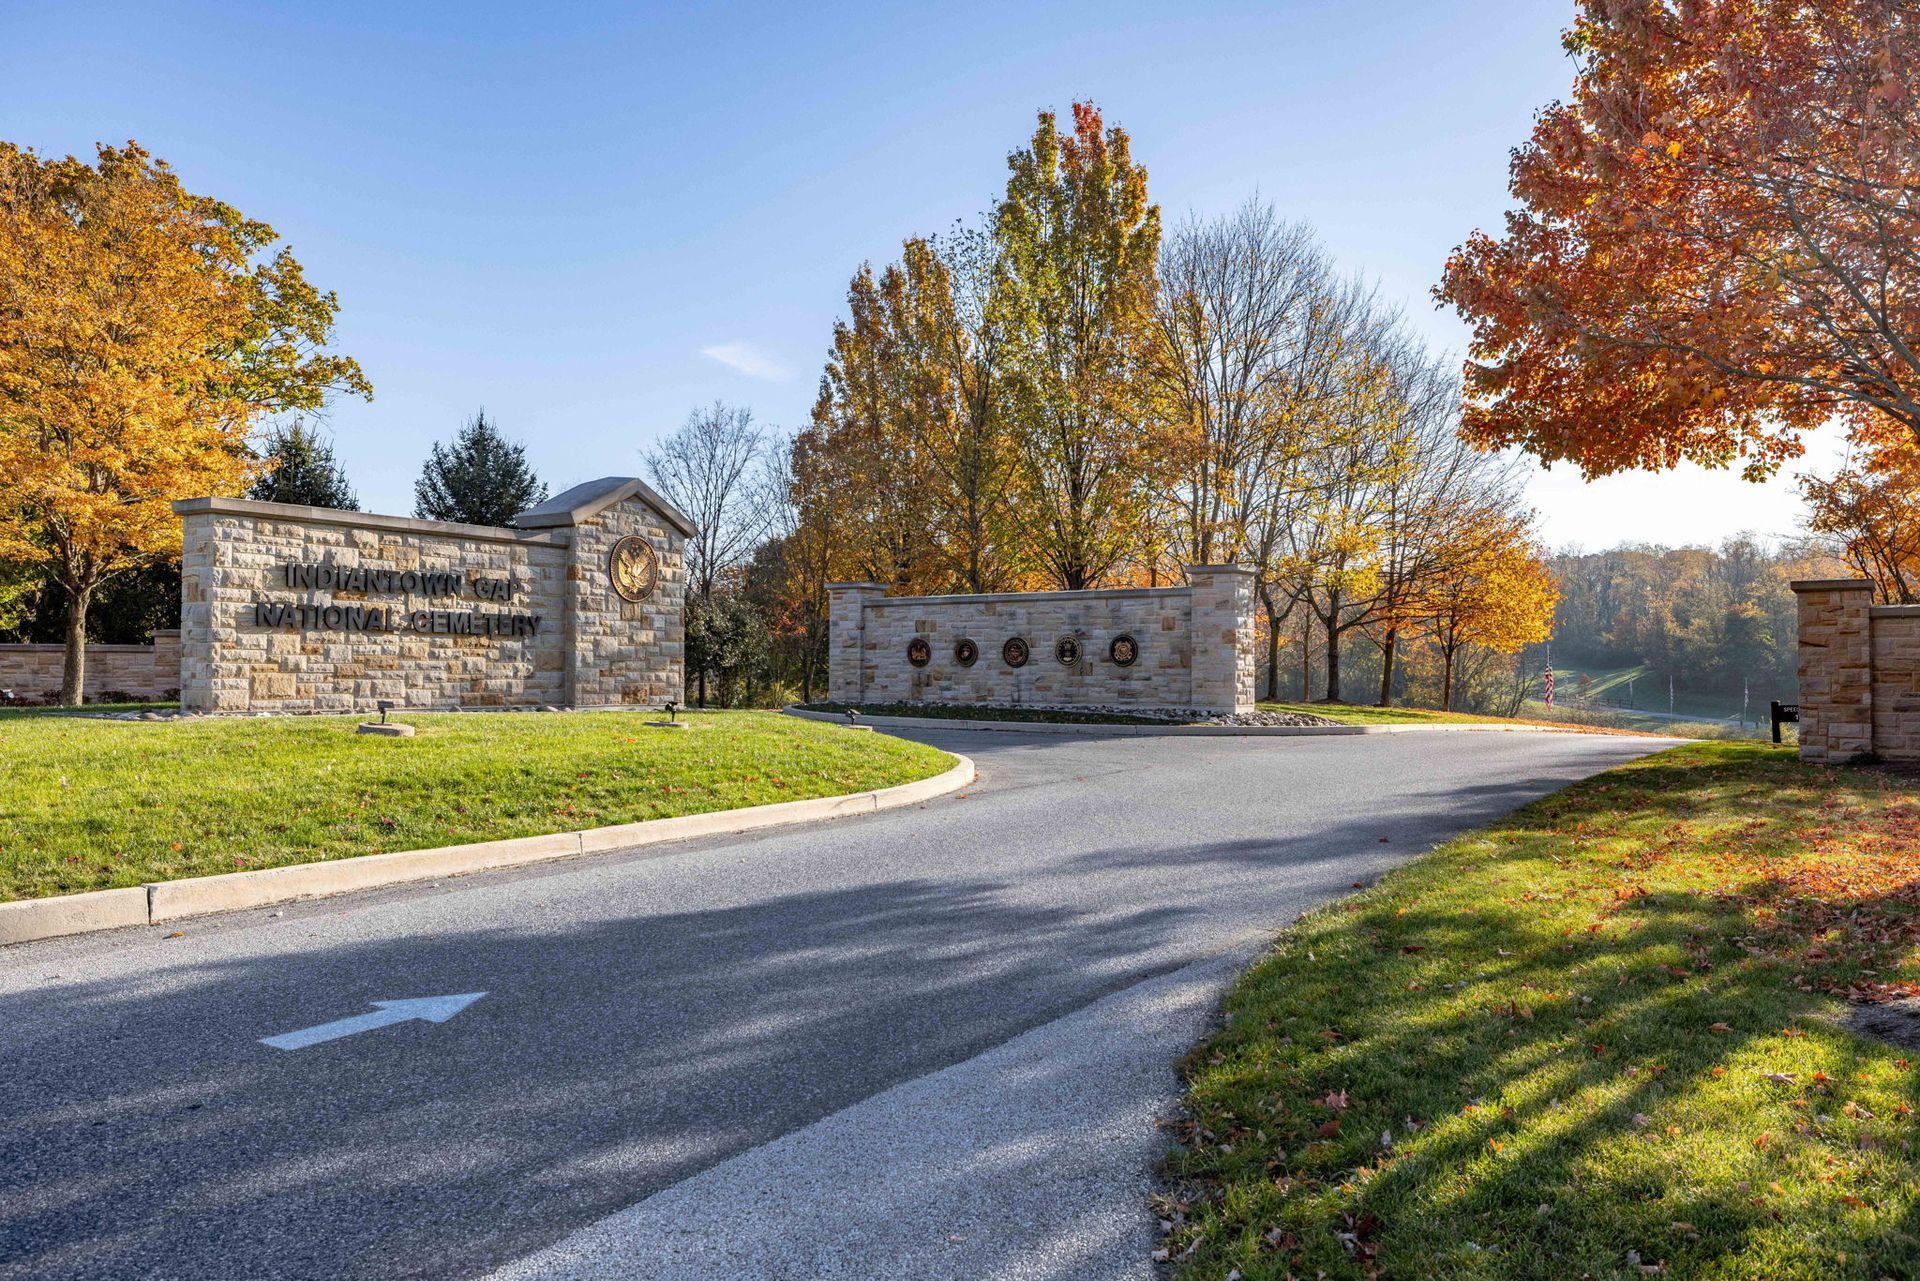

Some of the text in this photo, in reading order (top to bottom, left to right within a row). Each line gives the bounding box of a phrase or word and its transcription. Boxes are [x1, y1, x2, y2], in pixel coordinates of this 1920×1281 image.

[286, 562, 521, 600] INDIANTOWN GAP
[256, 602, 542, 636] NATIONAL CEMETERY
